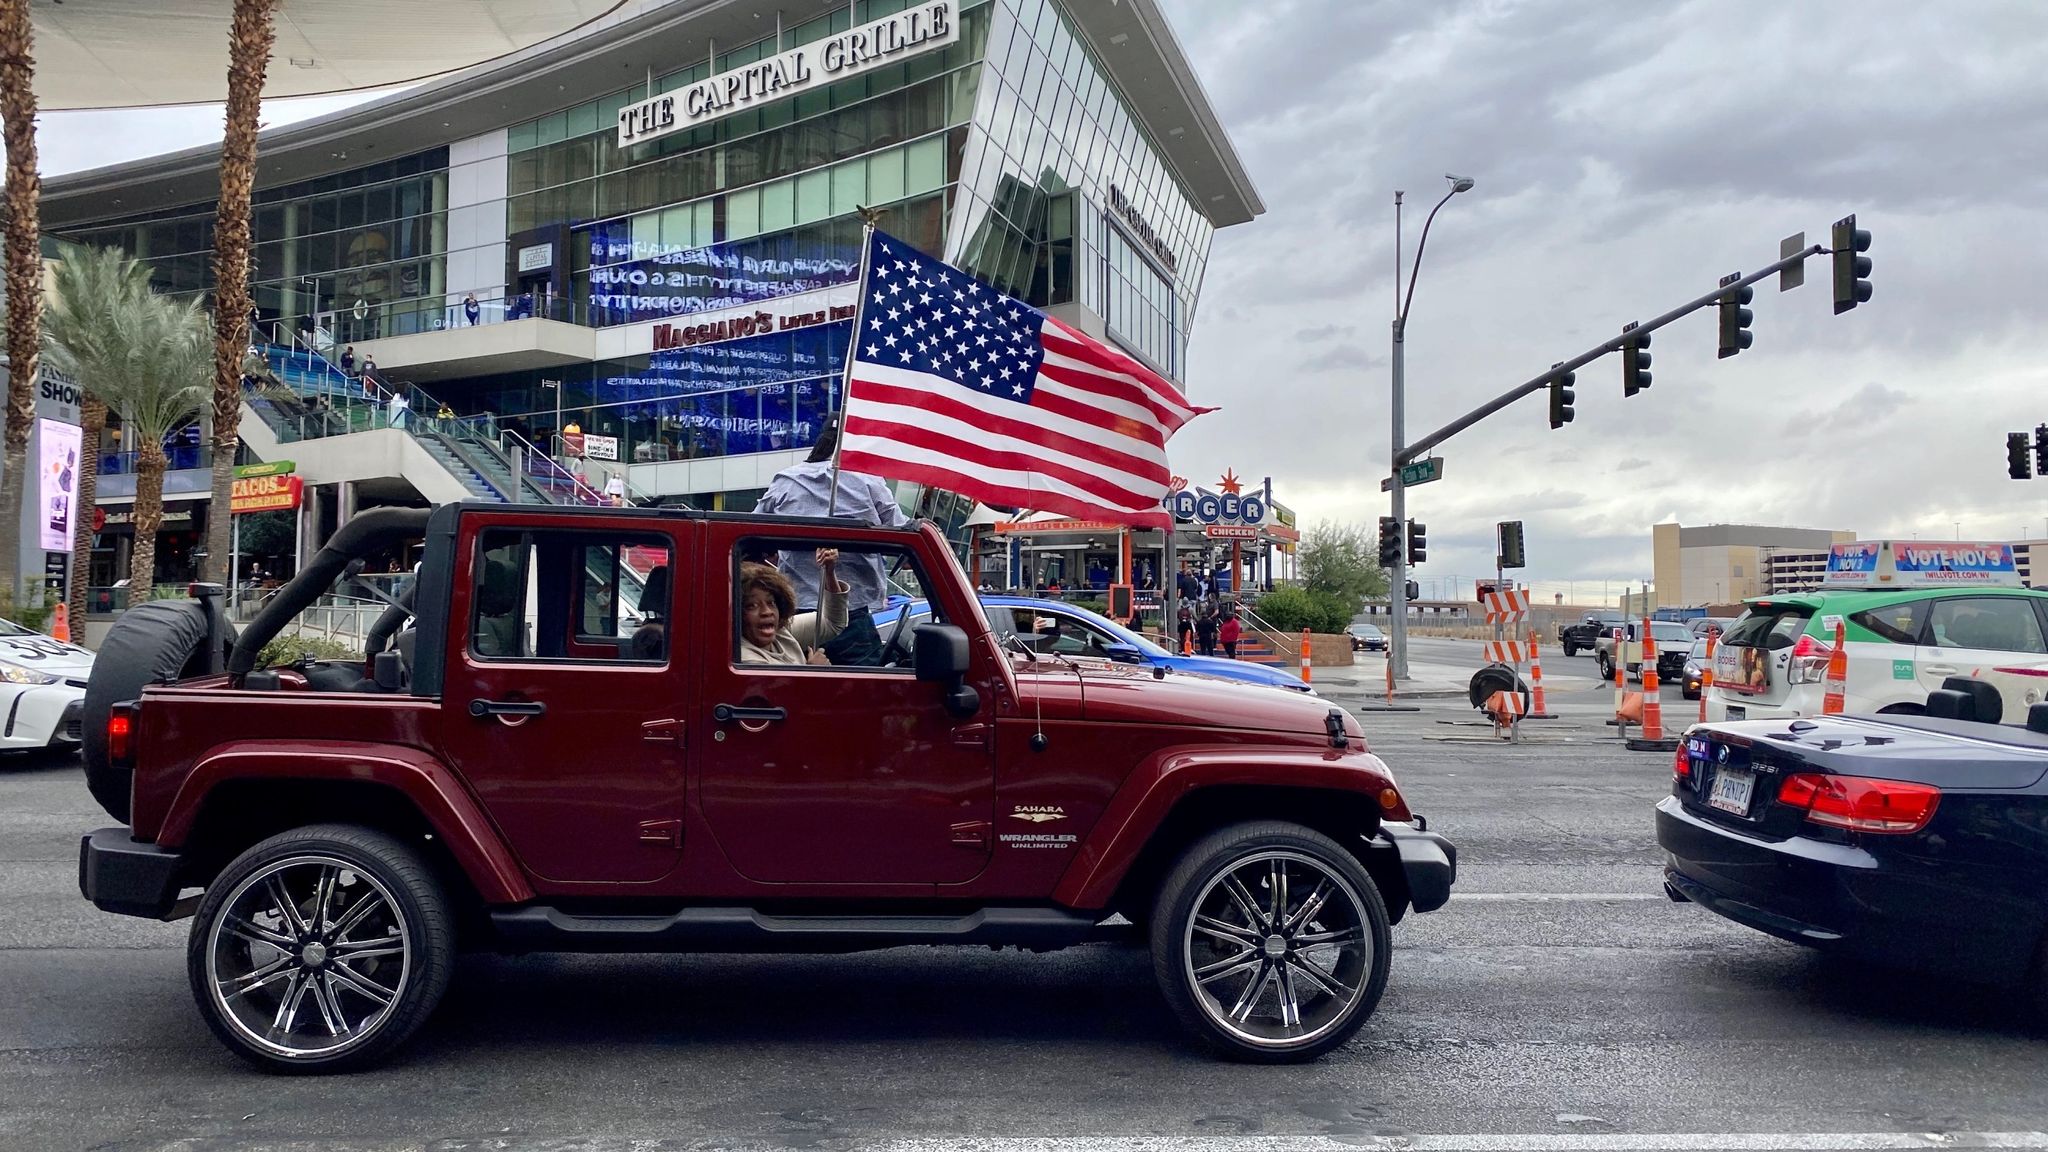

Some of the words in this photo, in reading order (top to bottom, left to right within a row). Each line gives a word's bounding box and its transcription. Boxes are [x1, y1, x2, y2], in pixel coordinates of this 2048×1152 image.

[621, 95, 674, 138] THE
[684, 52, 810, 118] CAPITAL
[820, 2, 950, 73] GRILLE
[653, 311, 773, 350] MAGGIANO'S
[231, 477, 278, 498] TACOS
[1068, 521, 1104, 530] SHAKES
[1211, 527, 1255, 537] CHICKEN
[1843, 546, 1863, 558] VOTE
[1906, 548, 1952, 566] VOTE
[1952, 549, 1986, 567] NOV
[1987, 550, 2001, 567] 3
[1839, 558, 1857, 570] NOV
[1856, 558, 1863, 570] 3
[1718, 655, 1737, 666] BODIES
[1014, 805, 1064, 813] SAHARA
[999, 834, 1078, 842] WRANGLER
